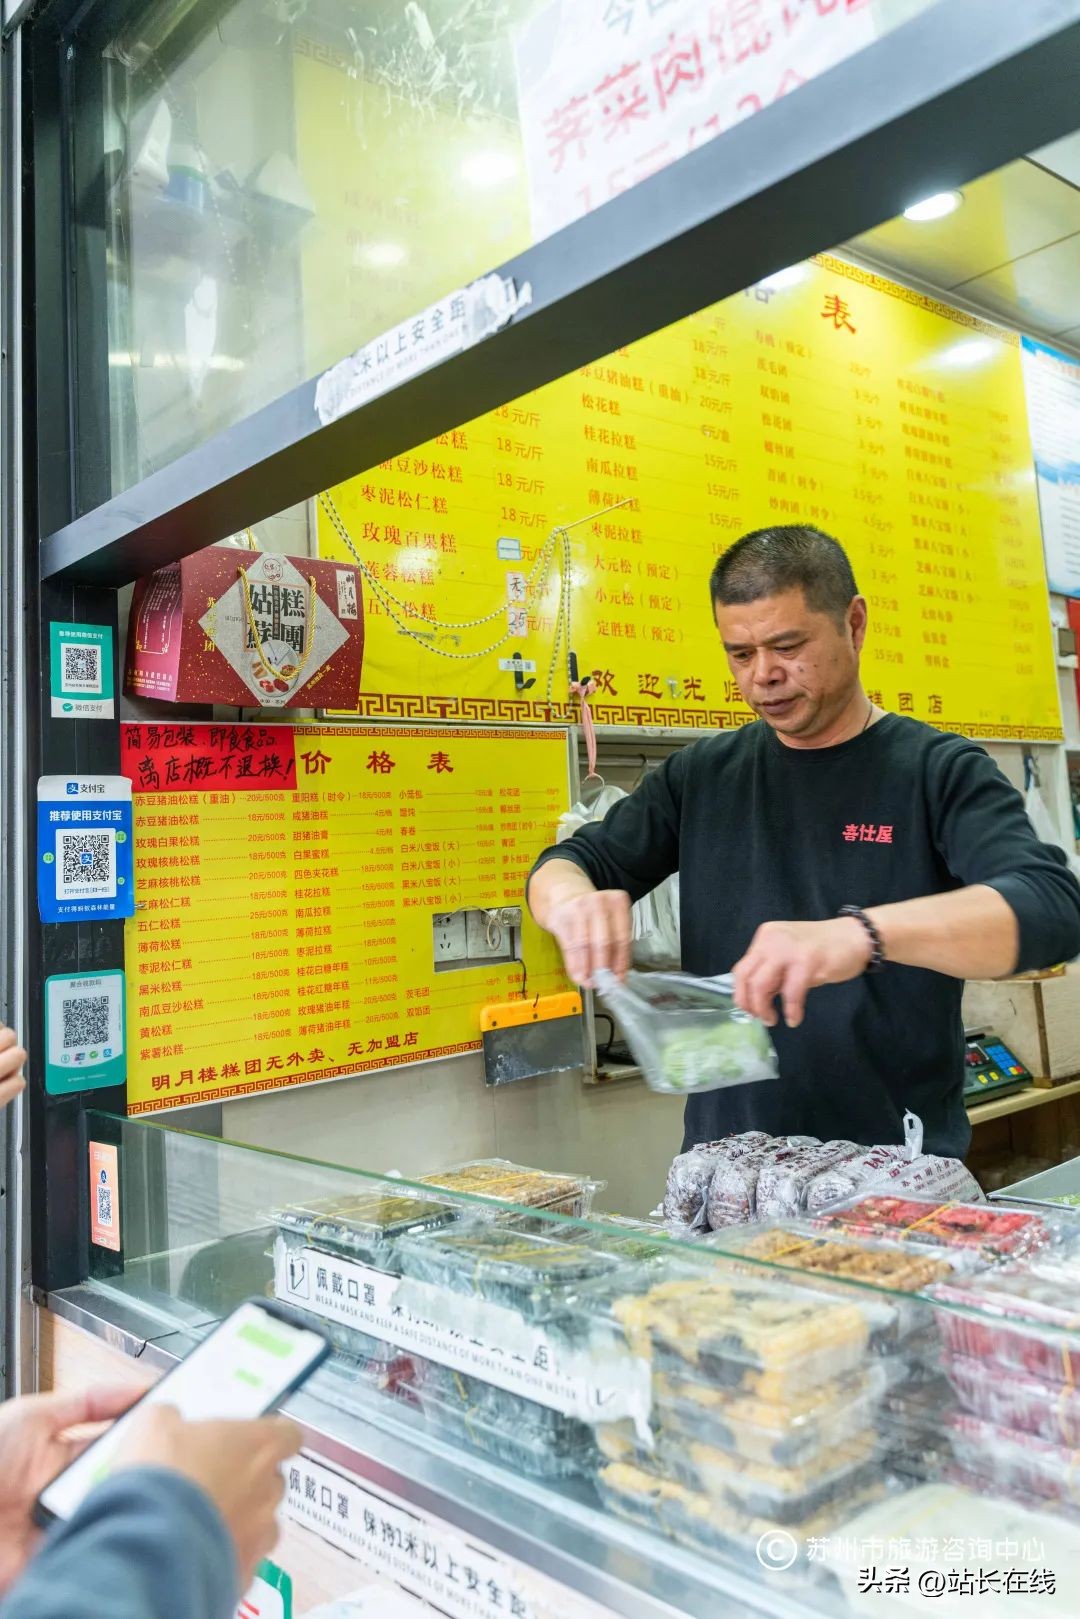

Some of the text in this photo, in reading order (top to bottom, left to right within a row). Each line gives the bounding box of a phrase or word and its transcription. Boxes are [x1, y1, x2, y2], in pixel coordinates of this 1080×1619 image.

[497, 437, 543, 461] 18元/斤
[497, 472, 545, 495] 18元/斤
[361, 484, 547, 529] 枣泥松仁糕 18元/斤
[363, 522, 457, 553] 玫瑰百果糕
[368, 598, 437, 620] 五仁松糕
[300, 750, 454, 775] 价格表
[80, 784, 105, 793] 支付宝
[50, 811, 122, 821] 推荐使用支付宝
[135, 815, 200, 827] 赤豆猪油松糕
[135, 836, 200, 849] 玫瑰白果松糕
[136, 856, 201, 869] 玫瑰核桃松糕
[137, 876, 201, 890] 芝麻核桃松糕
[295, 887, 331, 899] 桂花拉糕
[138, 896, 191, 911] 芝麻松仁糕
[295, 906, 331, 919] 南瓜拉糕
[137, 918, 181, 932] 五仁松糕
[138, 939, 181, 953] 薄荷松糕
[138, 959, 192, 975] 枣泥松仁糕
[139, 981, 182, 996] 黑米松糕
[139, 999, 204, 1018] 南瓜豆沙松糕
[140, 1025, 172, 1039] 黄松糕
[140, 1044, 184, 1061] 紫薯松糕
[317, 1267, 375, 1307] 佩戴口罩
[290, 1467, 349, 1519] 佩戴口罩
